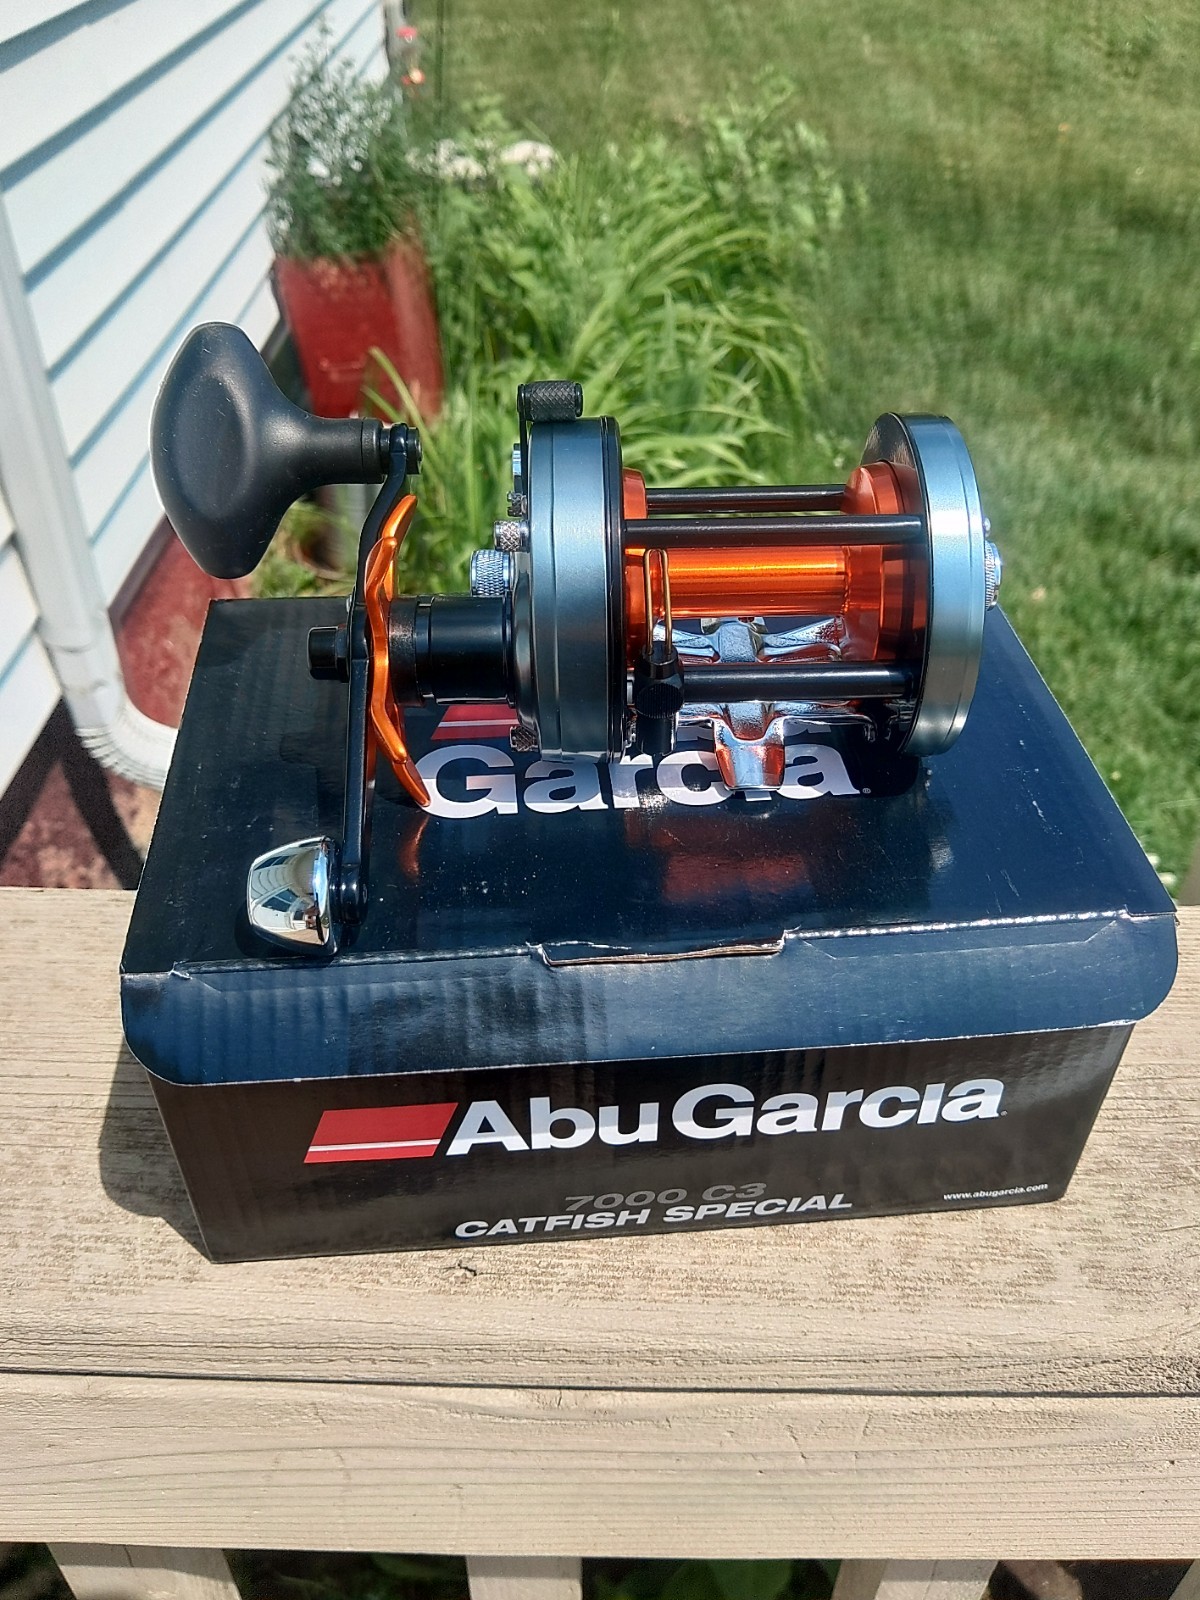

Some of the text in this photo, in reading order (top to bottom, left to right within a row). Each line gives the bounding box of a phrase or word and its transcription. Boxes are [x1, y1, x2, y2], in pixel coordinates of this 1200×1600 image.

[414, 743, 861, 819] Garca
[446, 1078, 1005, 1157] Abu Garcia
[565, 1182, 767, 1212] 7000 C3
[943, 1183, 1049, 1200] www.abugarcia.com
[454, 1193, 853, 1239] CATFISH SPECIAL
